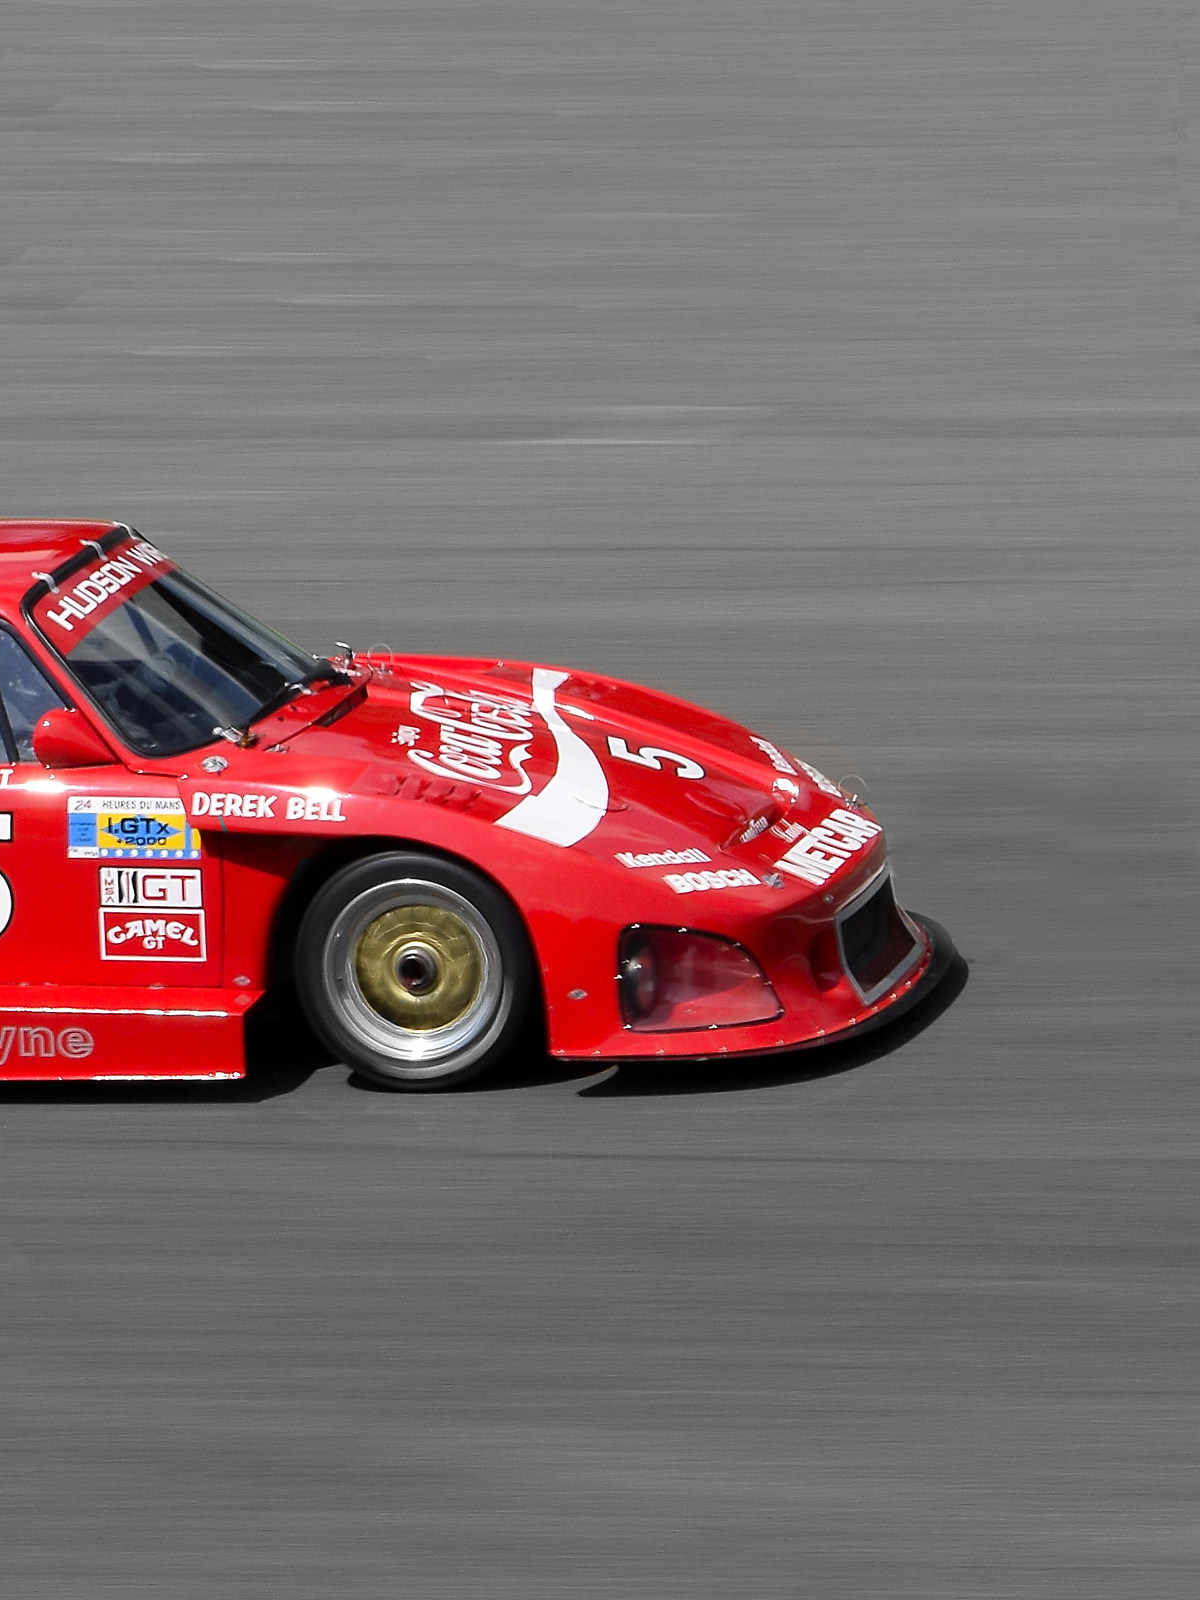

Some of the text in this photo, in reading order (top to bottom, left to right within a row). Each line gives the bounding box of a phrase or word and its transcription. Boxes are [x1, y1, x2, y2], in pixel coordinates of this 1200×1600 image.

[46, 555, 142, 631] HUDSON
[606, 735, 705, 780] 5
[191, 791, 346, 822] DEREK BELL
[613, 848, 712, 869] Kendall
[773, 808, 883, 886] METCAR
[142, 875, 196, 902] GT
[661, 868, 762, 894] BOSCH
[106, 919, 199, 946] CAMEL
[142, 936, 166, 949] GT
